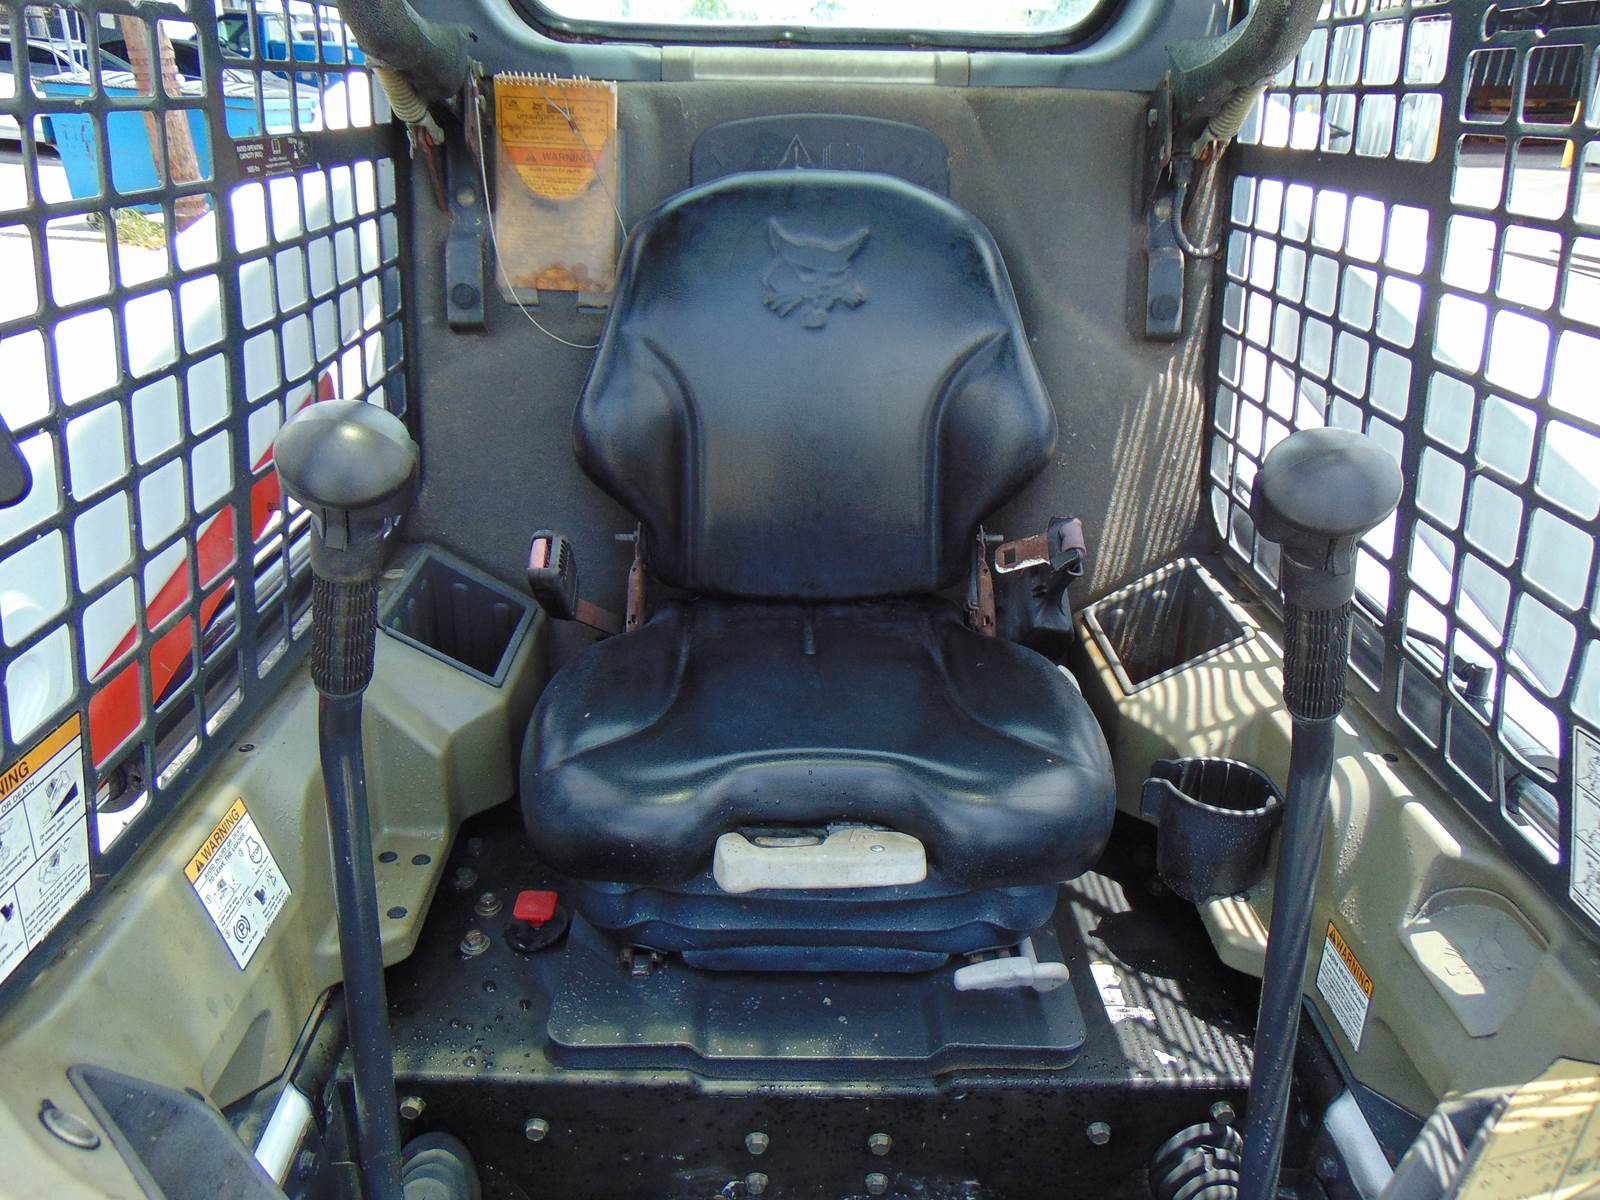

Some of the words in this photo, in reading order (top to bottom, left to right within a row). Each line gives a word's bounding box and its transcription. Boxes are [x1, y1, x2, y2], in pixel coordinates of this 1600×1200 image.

[1, 800, 11, 812] OR
[12, 781, 35, 802] DEATH
[201, 809, 240, 861] WARNING
[1334, 936, 1370, 993] WARNING
